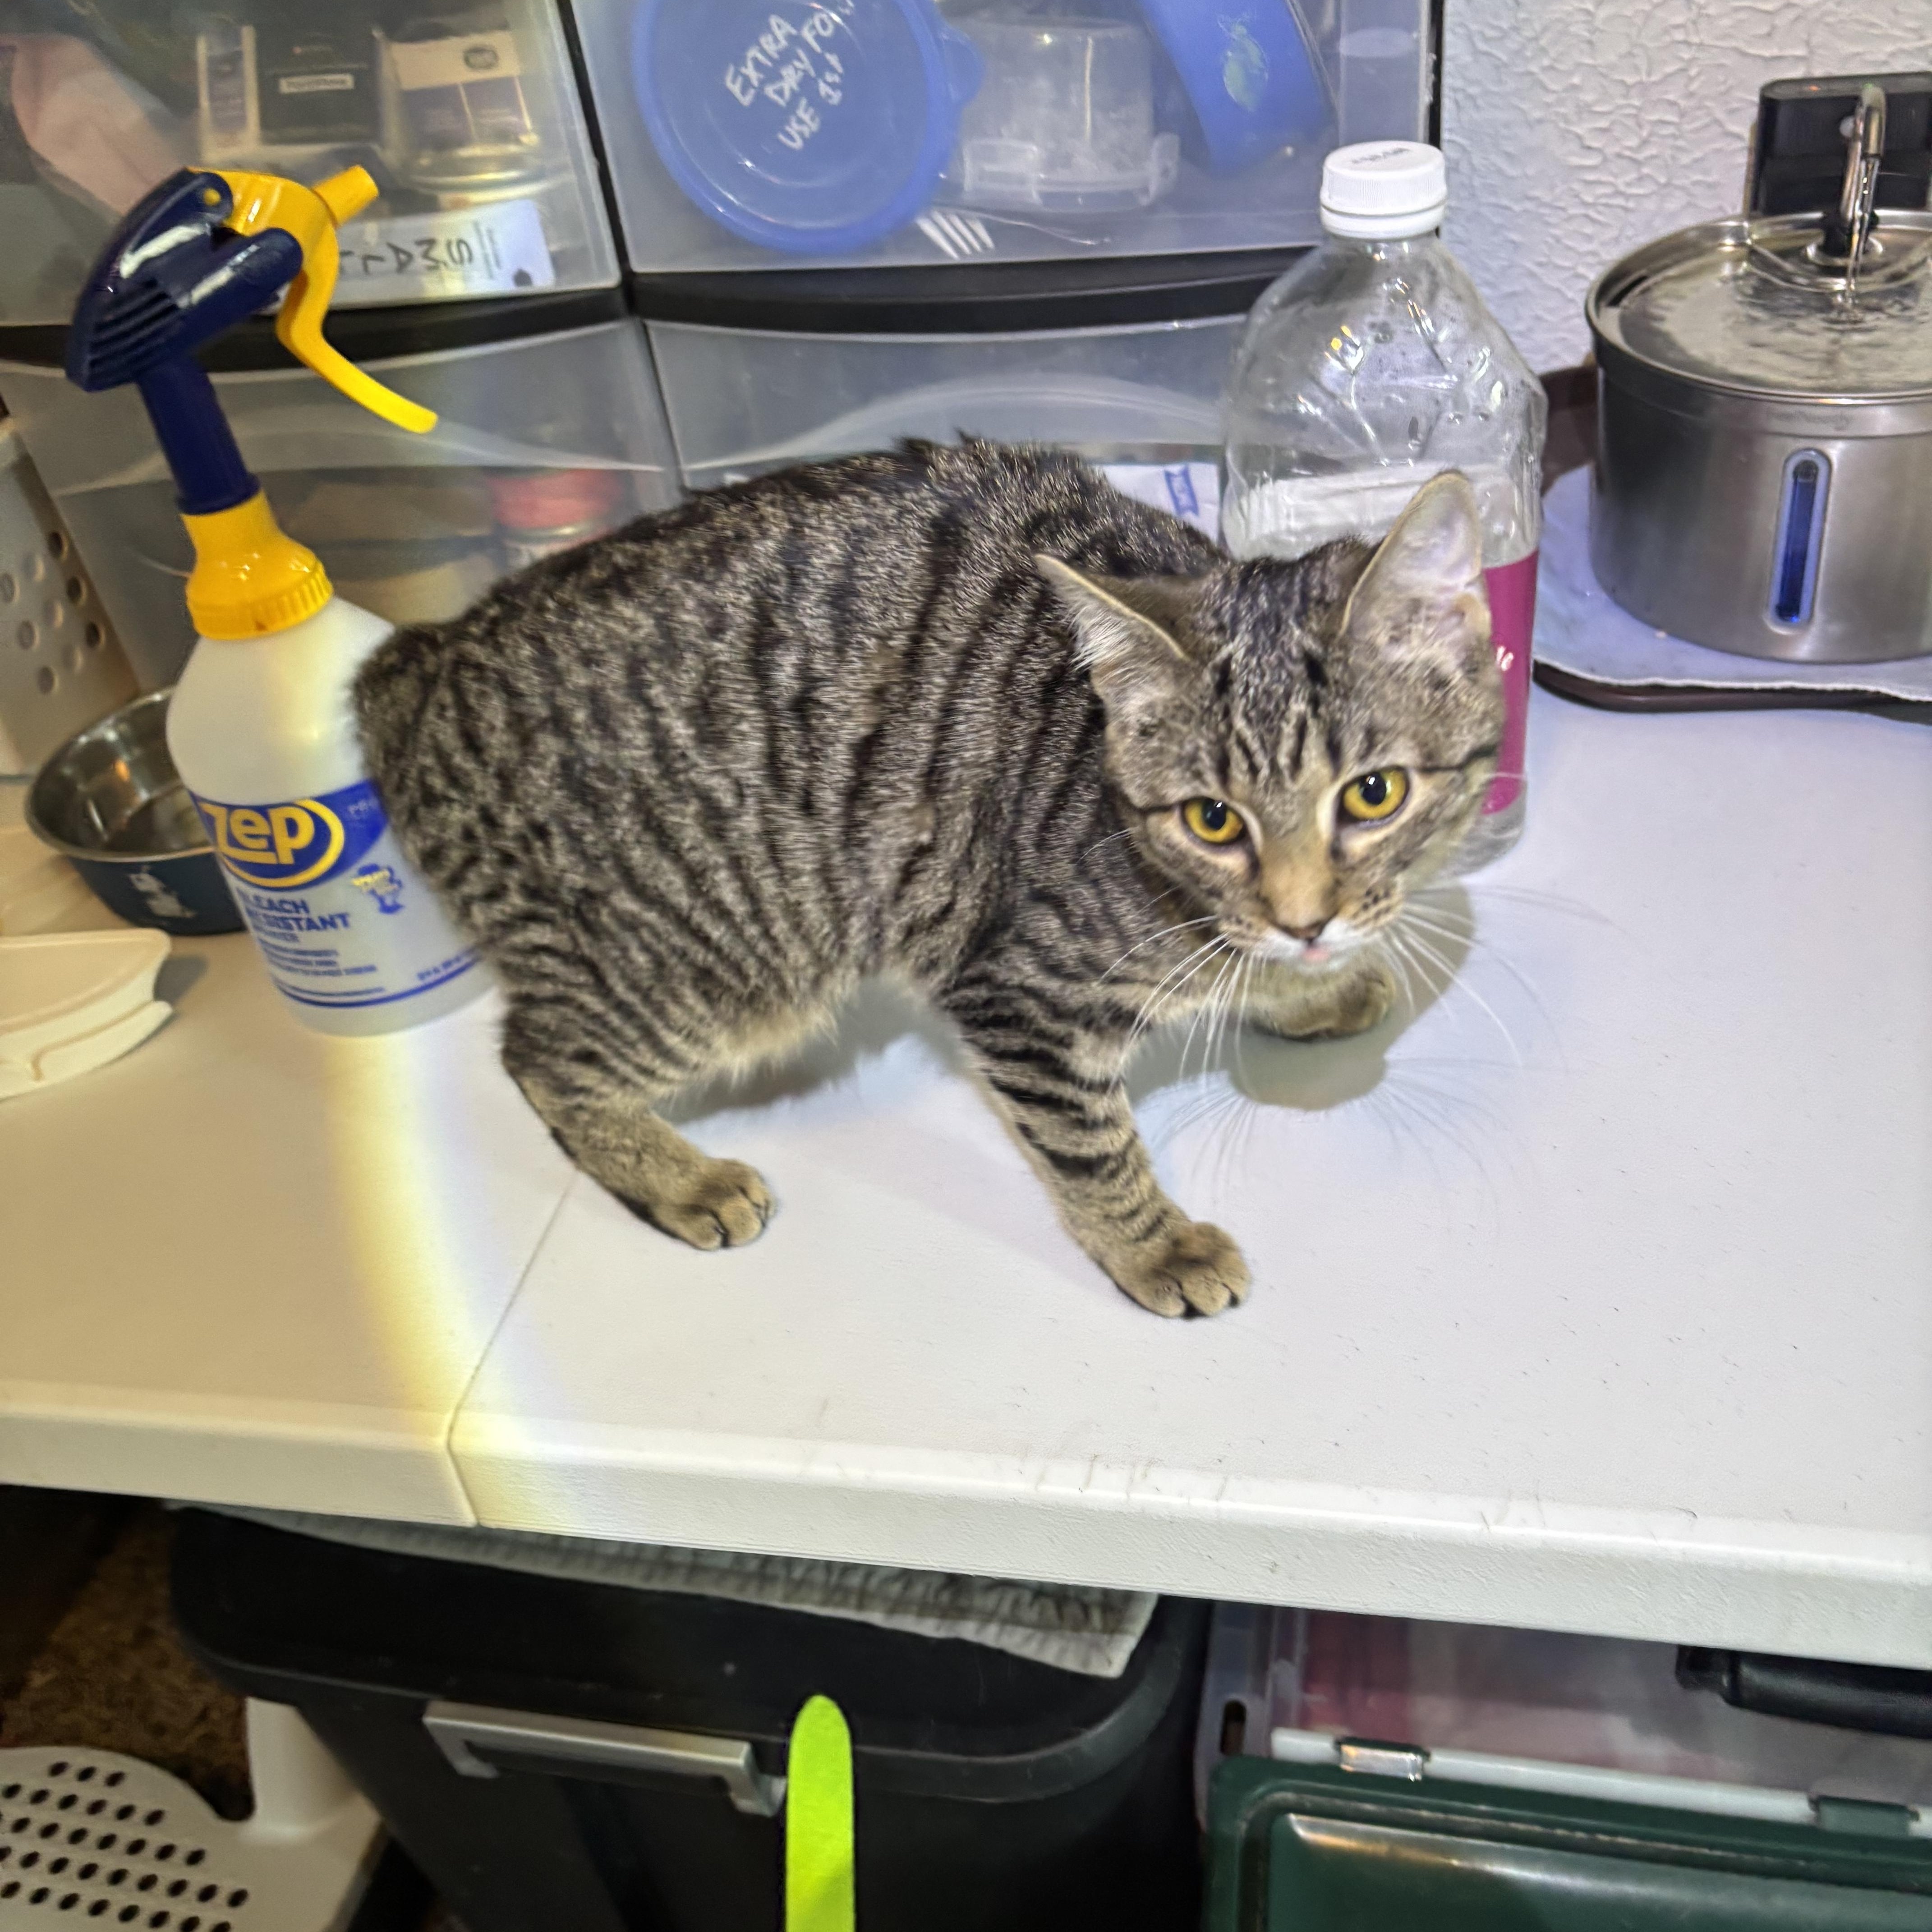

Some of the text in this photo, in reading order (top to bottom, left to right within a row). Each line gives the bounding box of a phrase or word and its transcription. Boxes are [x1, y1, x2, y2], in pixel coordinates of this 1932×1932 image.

[725, 14, 797, 106] EXTRA
[764, 48, 815, 107] DRY
[777, 97, 821, 150] USE
